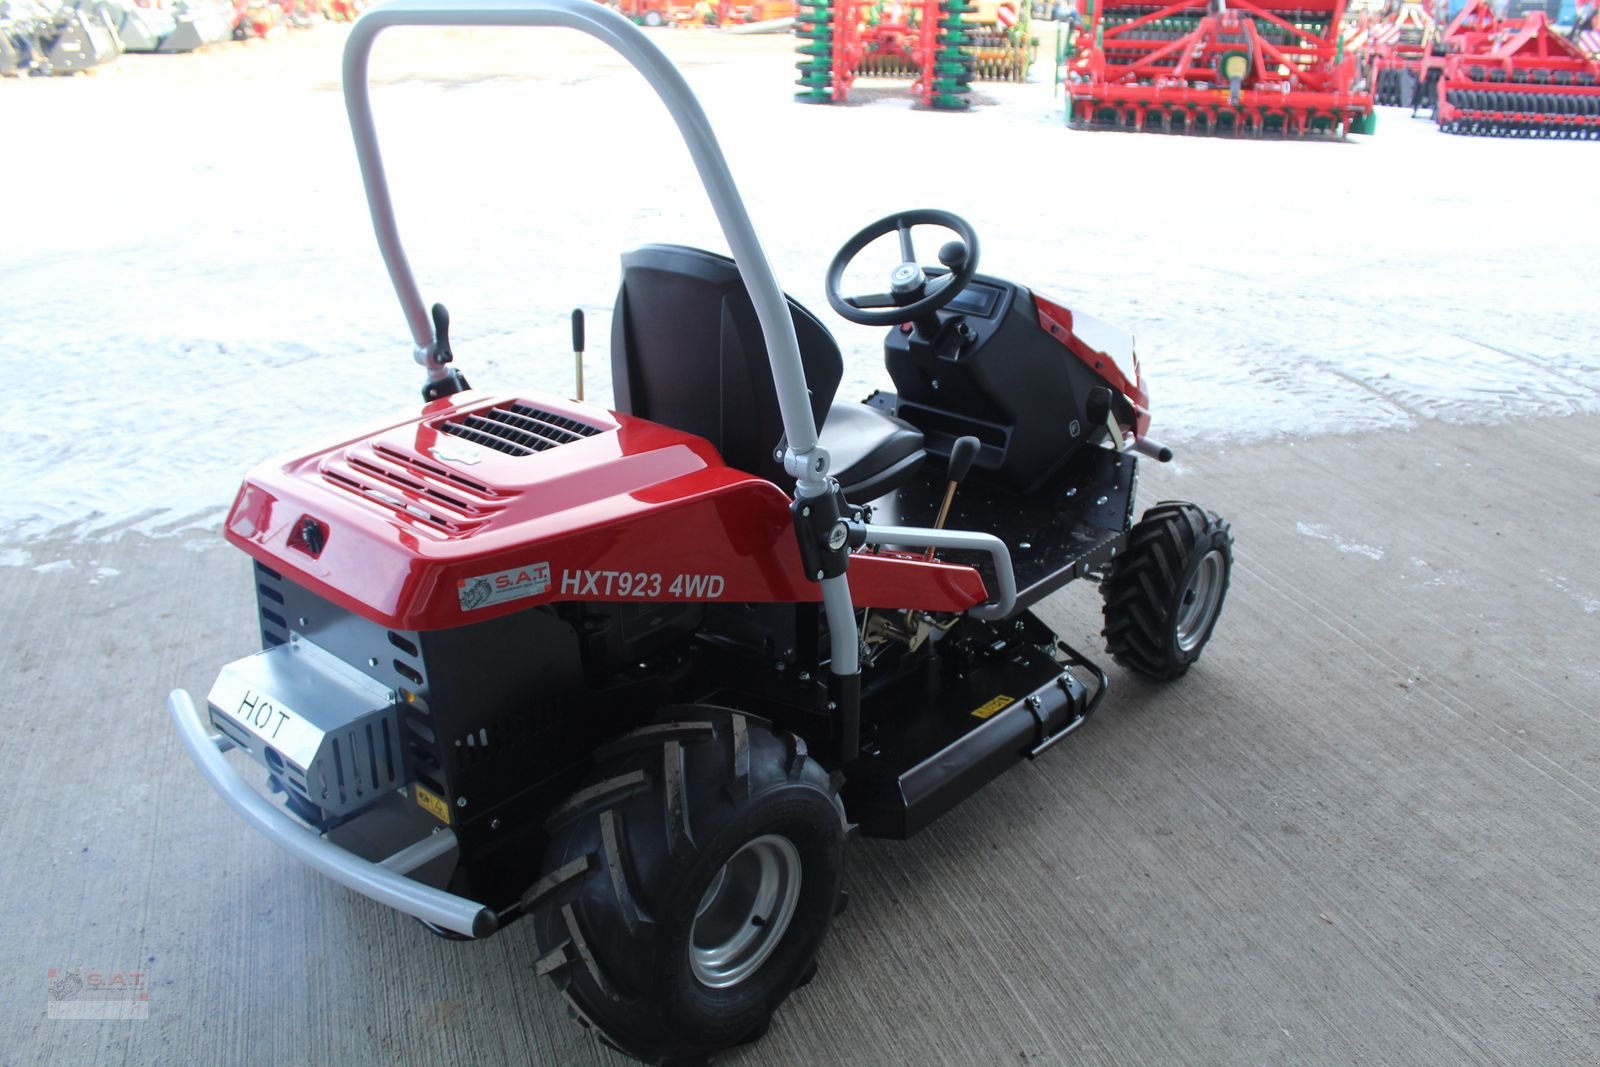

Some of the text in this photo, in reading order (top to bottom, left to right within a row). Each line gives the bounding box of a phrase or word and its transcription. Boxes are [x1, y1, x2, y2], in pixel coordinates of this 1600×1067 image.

[495, 565, 548, 589] S.A.T.
[560, 569, 662, 597] HXT923
[668, 574, 725, 598] 4WD
[237, 689, 290, 739] HOT
